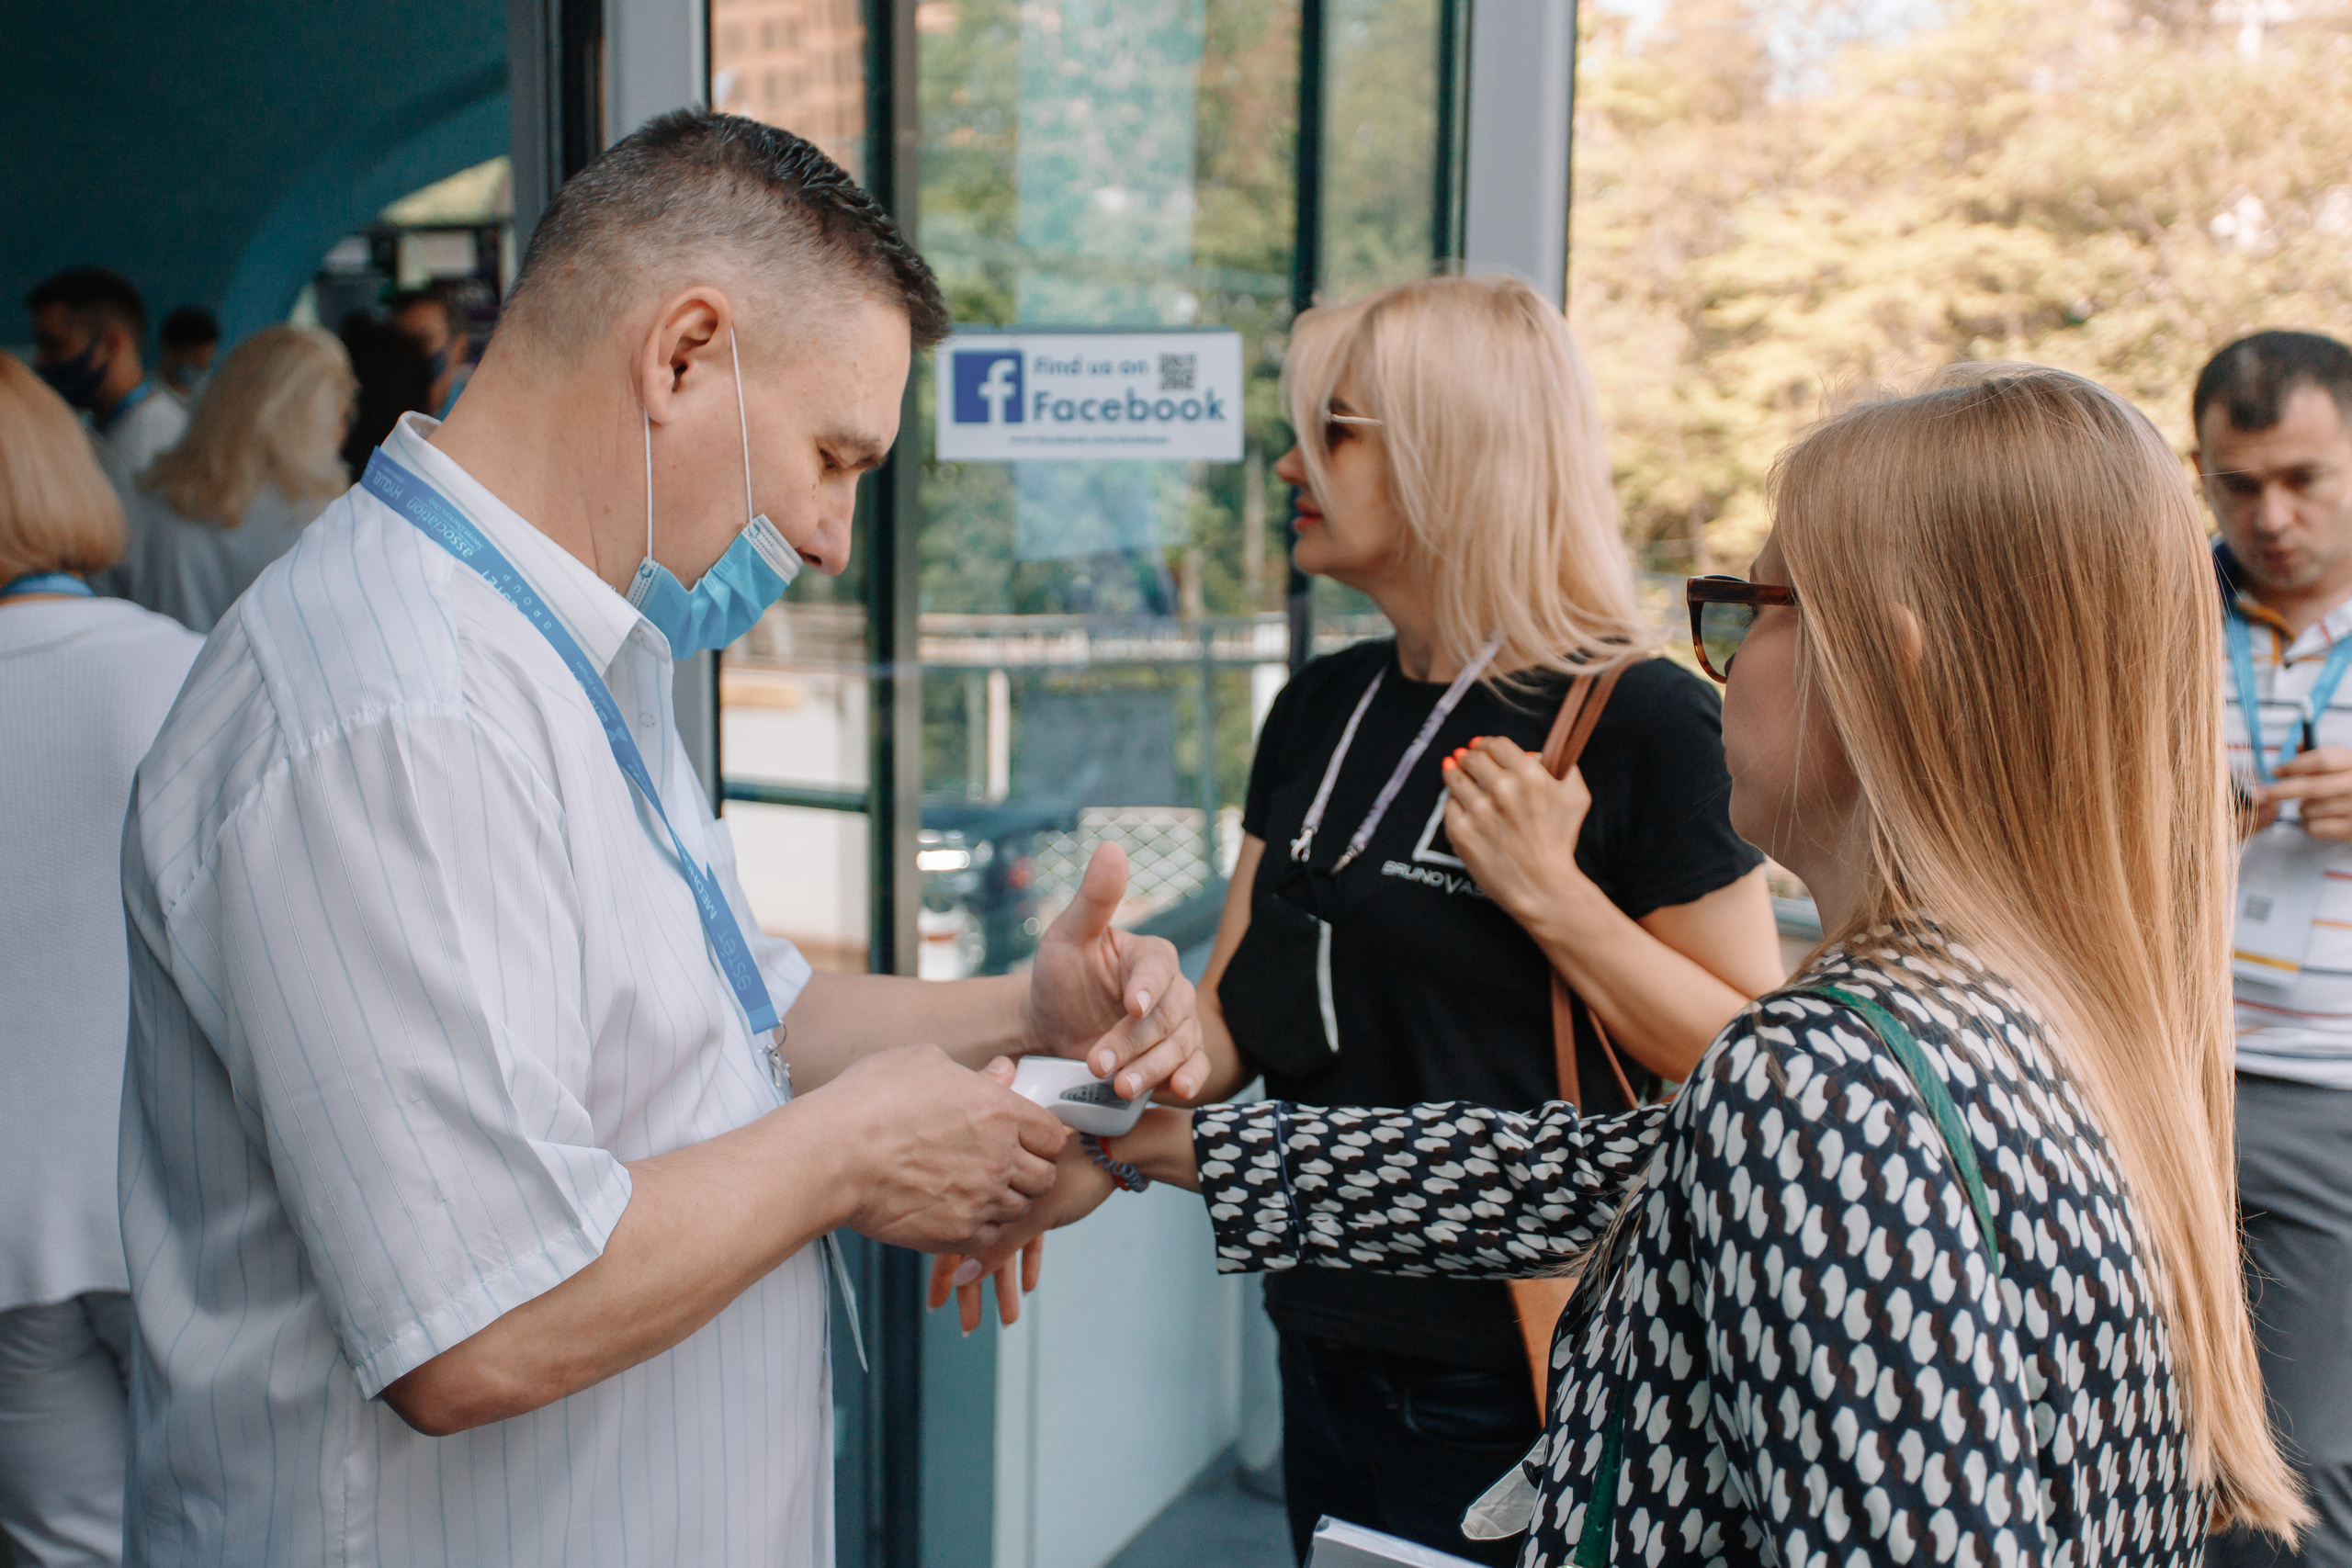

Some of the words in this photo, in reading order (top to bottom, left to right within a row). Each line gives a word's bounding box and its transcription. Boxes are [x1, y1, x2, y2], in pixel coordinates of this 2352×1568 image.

[1032, 355, 1083, 376] Find
[1090, 359, 1115, 376] us
[1120, 359, 1150, 376] on
[1033, 386, 1227, 422] Facebook
[406, 497, 474, 558] association
[503, 573, 552, 629] GROUP
